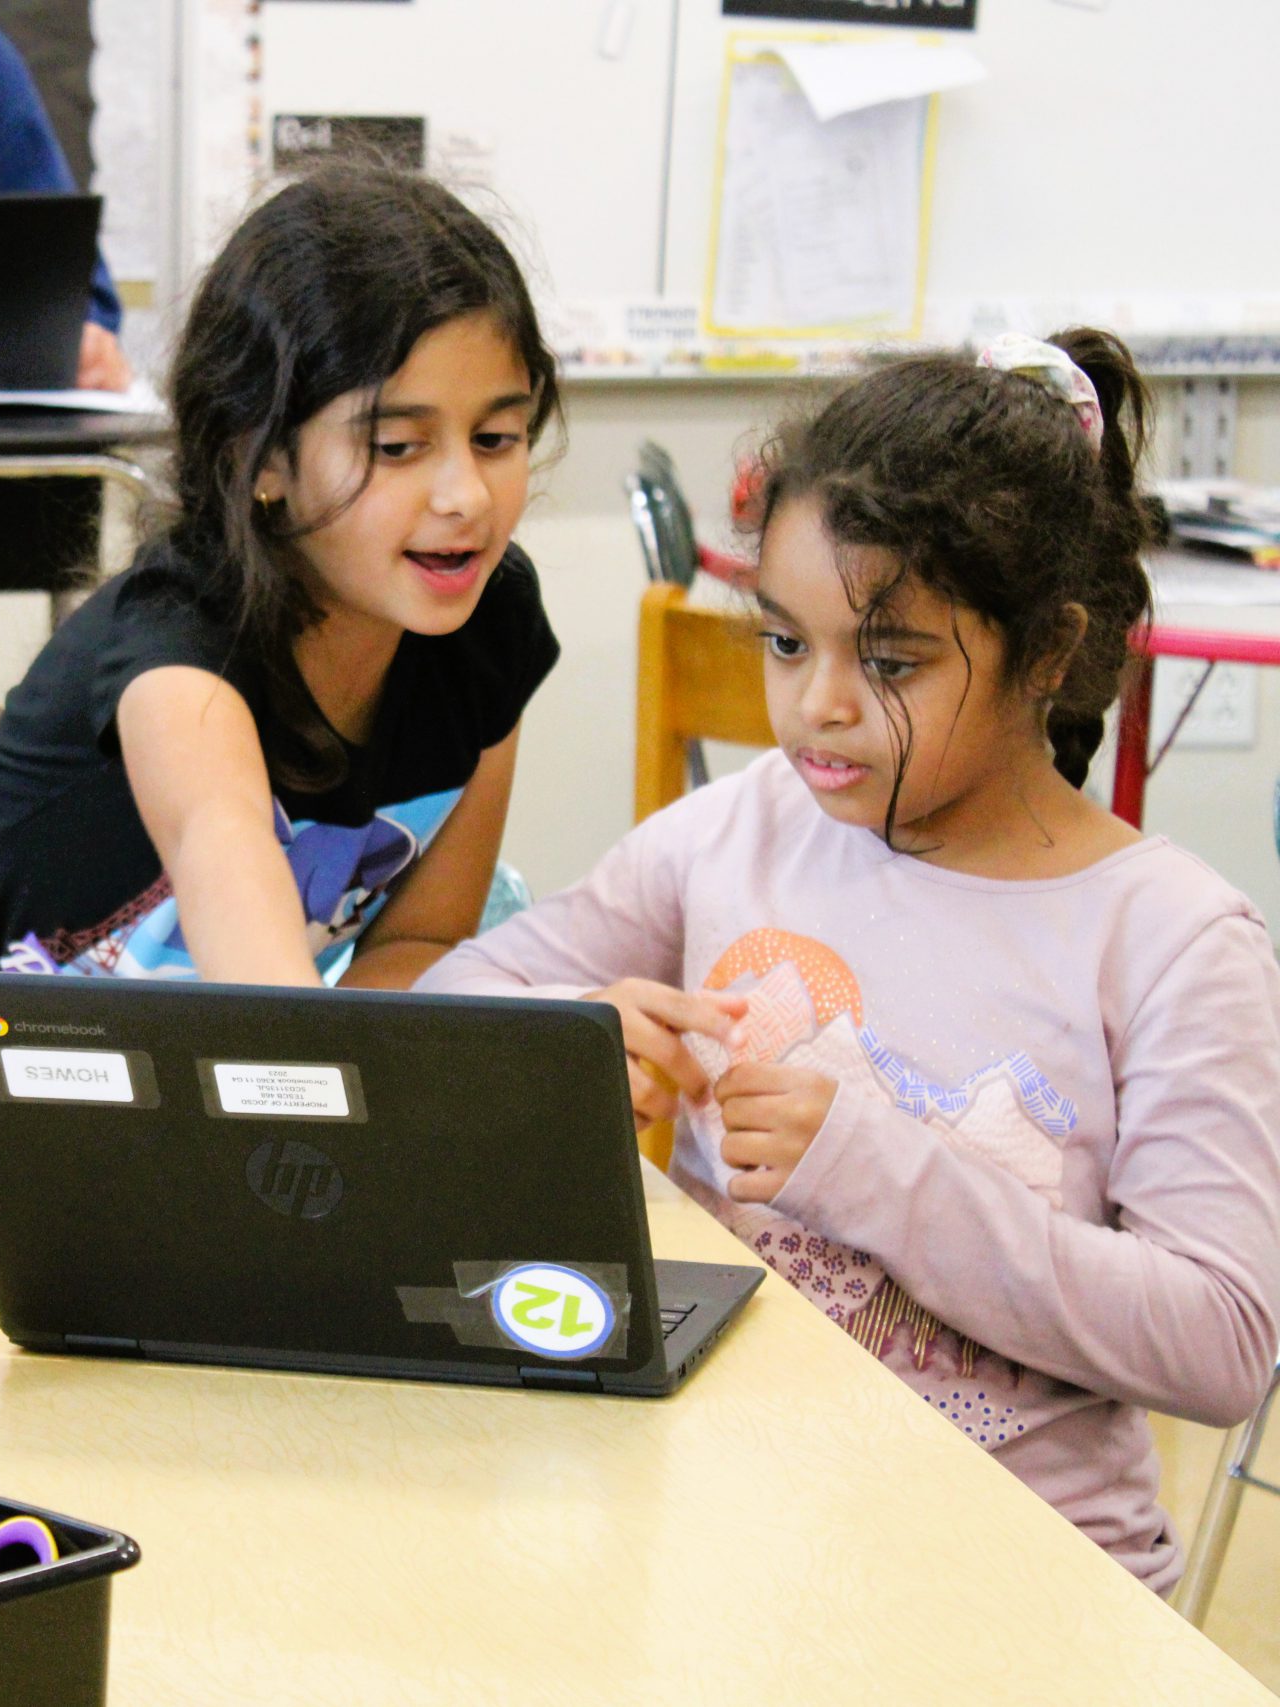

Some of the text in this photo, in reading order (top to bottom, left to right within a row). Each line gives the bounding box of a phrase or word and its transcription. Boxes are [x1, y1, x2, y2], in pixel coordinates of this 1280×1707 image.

[14, 1021, 107, 1036] chromebook
[24, 1066, 110, 1084] HOWES
[275, 1077, 328, 1085] Chromebook
[283, 1100, 328, 1108] PROPERTY
[255, 1140, 338, 1219] hp
[511, 1281, 594, 1338] 12
